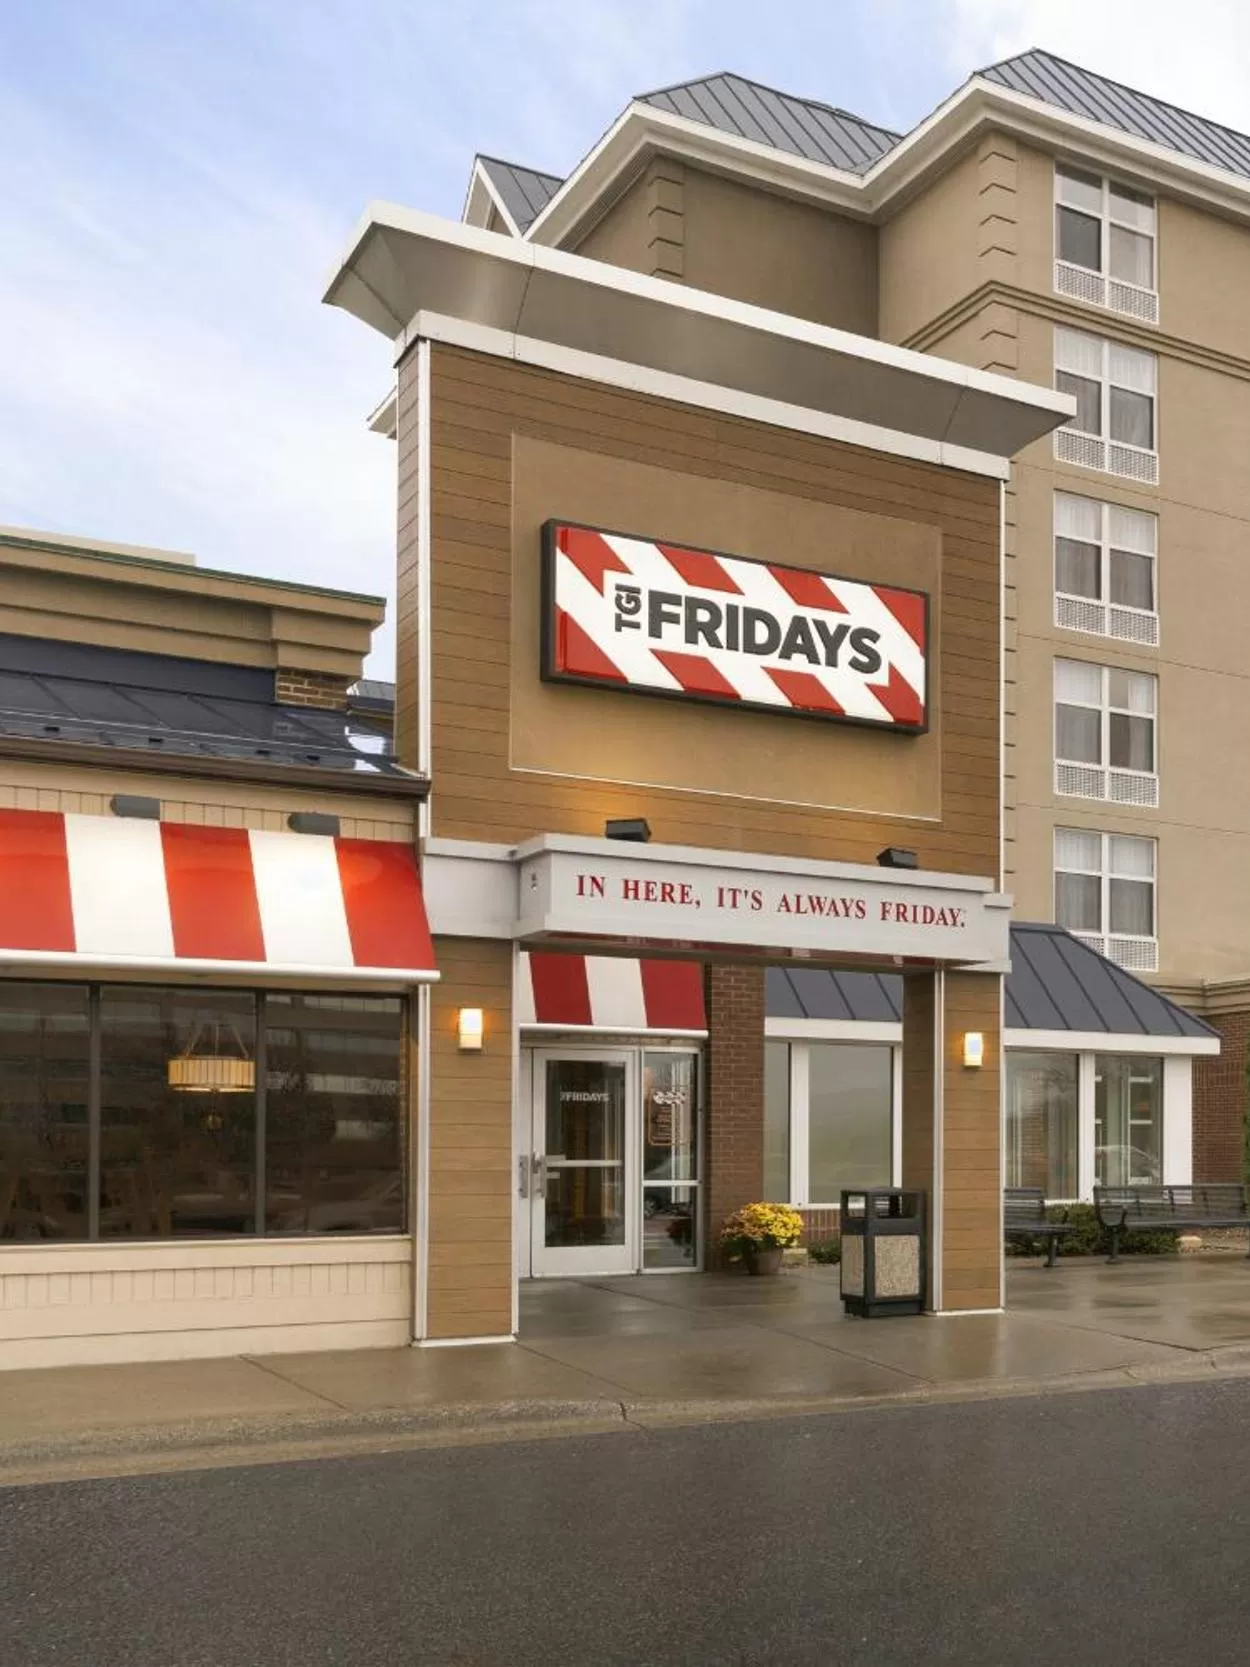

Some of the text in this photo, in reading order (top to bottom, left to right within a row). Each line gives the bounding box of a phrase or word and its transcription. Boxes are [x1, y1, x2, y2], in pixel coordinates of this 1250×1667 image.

[615, 583, 883, 675] TGI FRIDAYS
[576, 875, 966, 928] IN HERE, IT'S ALWAYS FRIDAY.
